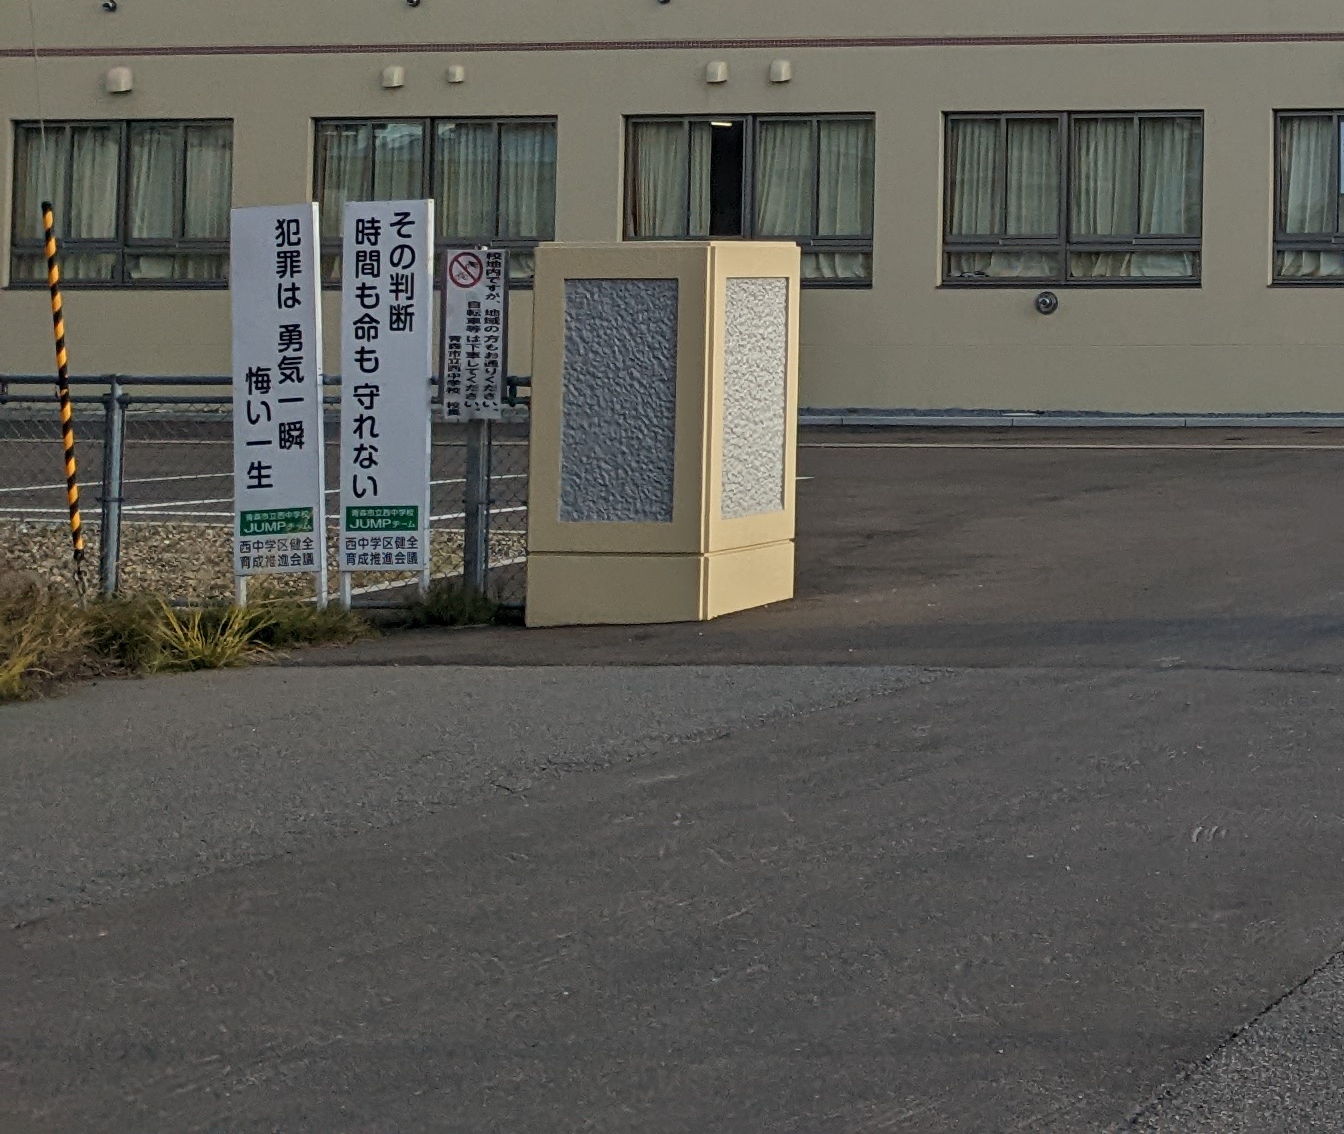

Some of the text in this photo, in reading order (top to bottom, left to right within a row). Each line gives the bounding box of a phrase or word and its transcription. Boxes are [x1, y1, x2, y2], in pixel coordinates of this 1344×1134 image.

[388, 211, 416, 333] その判断
[274, 218, 305, 451] 犯罪は 勇気一瞬
[245, 366, 274, 490] 悔い一生
[239, 536, 315, 553] 西中学区健全
[345, 536, 419, 550] 西中学区健全
[240, 552, 315, 569] 育成推進会議
[345, 552, 418, 566] 育成推進会議
